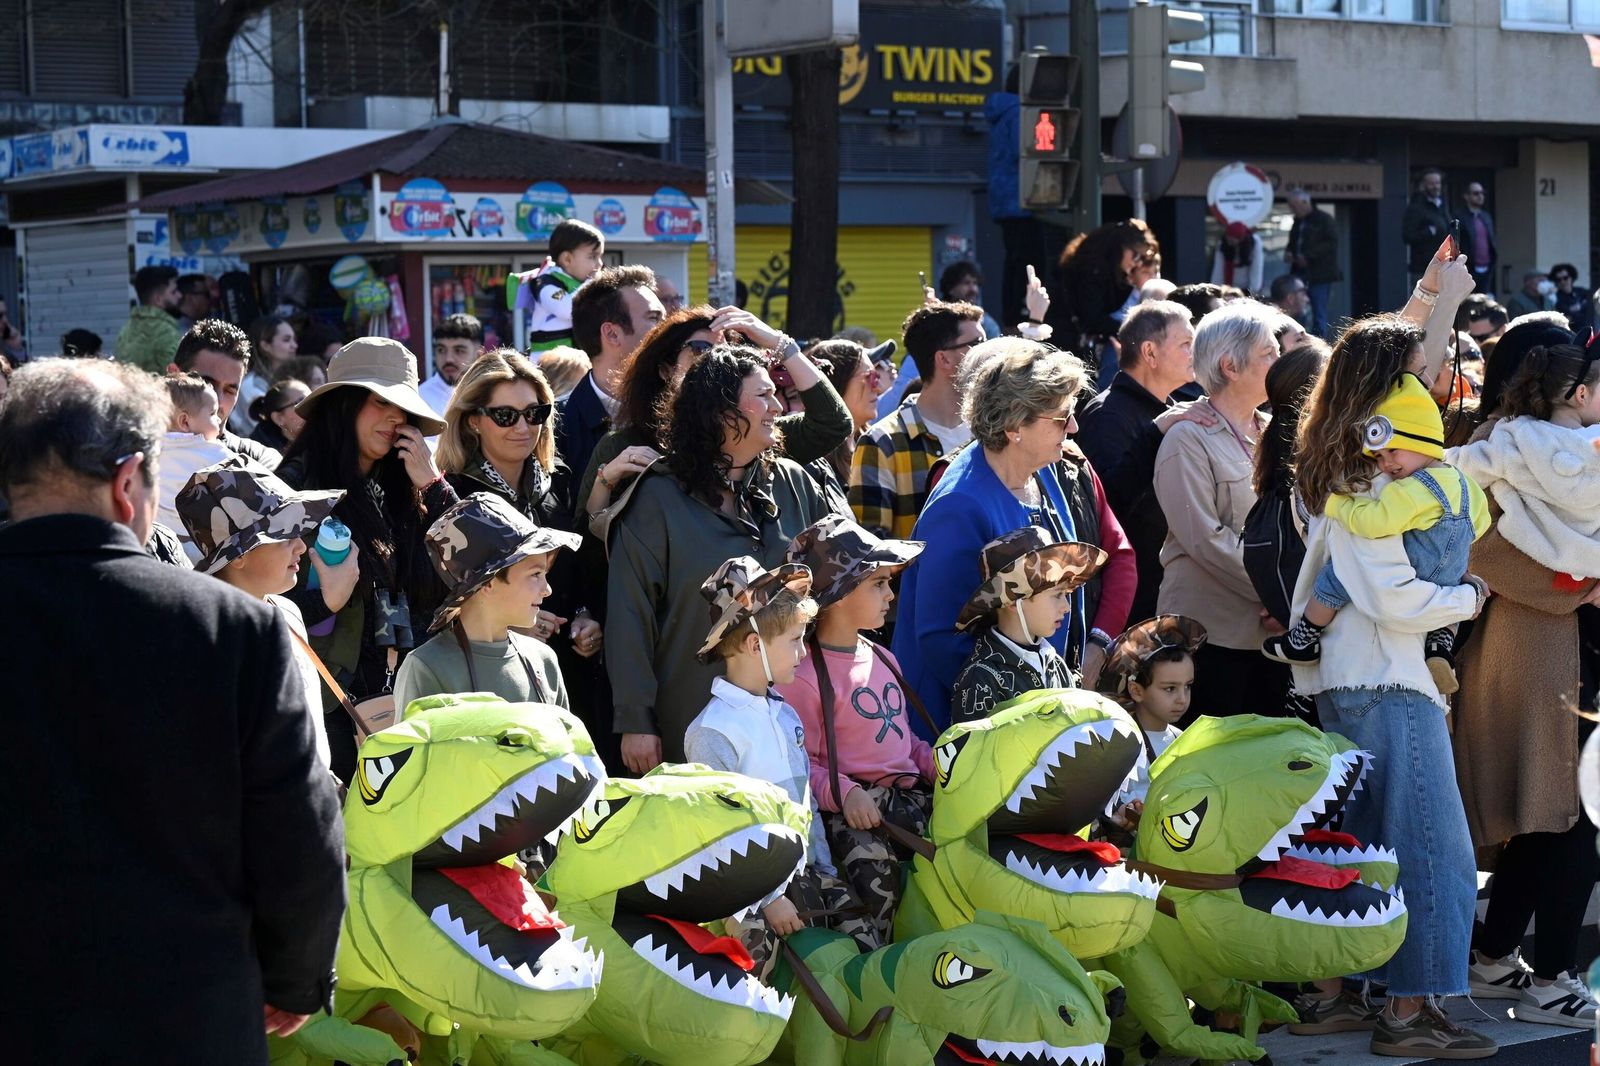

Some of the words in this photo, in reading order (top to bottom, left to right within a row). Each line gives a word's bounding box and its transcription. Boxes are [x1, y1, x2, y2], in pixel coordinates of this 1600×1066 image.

[875, 45, 993, 84] TWINS
[892, 91, 936, 103] BURGER
[938, 93, 985, 104] FACTORY
[102, 135, 160, 152] Orbit
[1539, 178, 1556, 196] 21
[403, 203, 441, 229] Orbit
[657, 209, 689, 233] Orbit
[146, 255, 199, 270] Orbit
